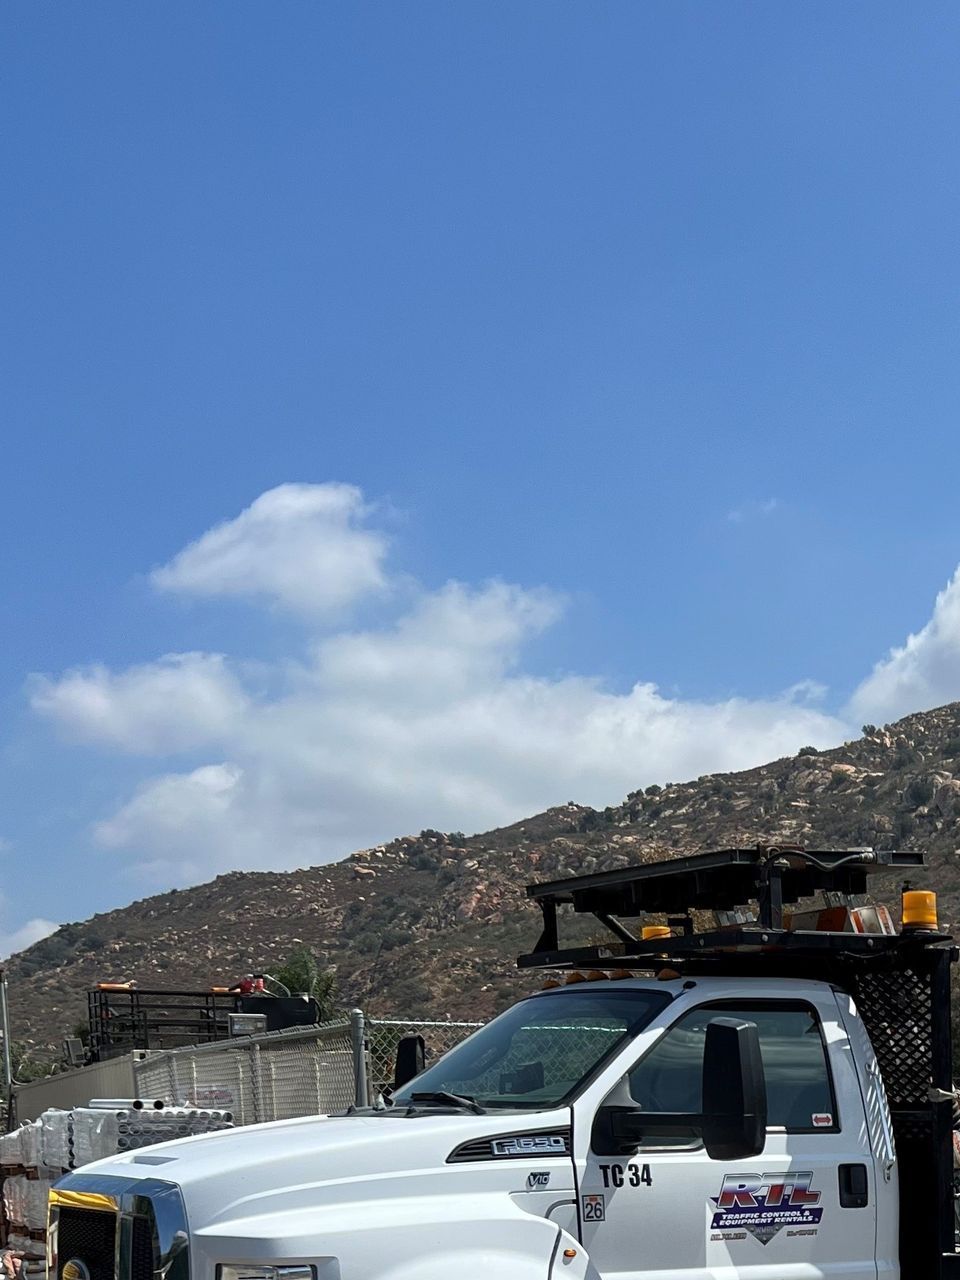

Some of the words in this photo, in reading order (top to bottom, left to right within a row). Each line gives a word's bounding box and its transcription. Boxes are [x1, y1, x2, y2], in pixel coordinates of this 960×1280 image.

[528, 1171, 550, 1187] V10
[599, 1164, 624, 1188] TC
[628, 1163, 652, 1187] 34
[717, 1171, 821, 1209] RTL
[585, 1202, 603, 1219] 26
[722, 1212, 759, 1220] TRAFFIC
[761, 1210, 801, 1218] CONTROL
[719, 1218, 771, 1226] EQUIPMENT
[774, 1215, 813, 1223] RENTALS
